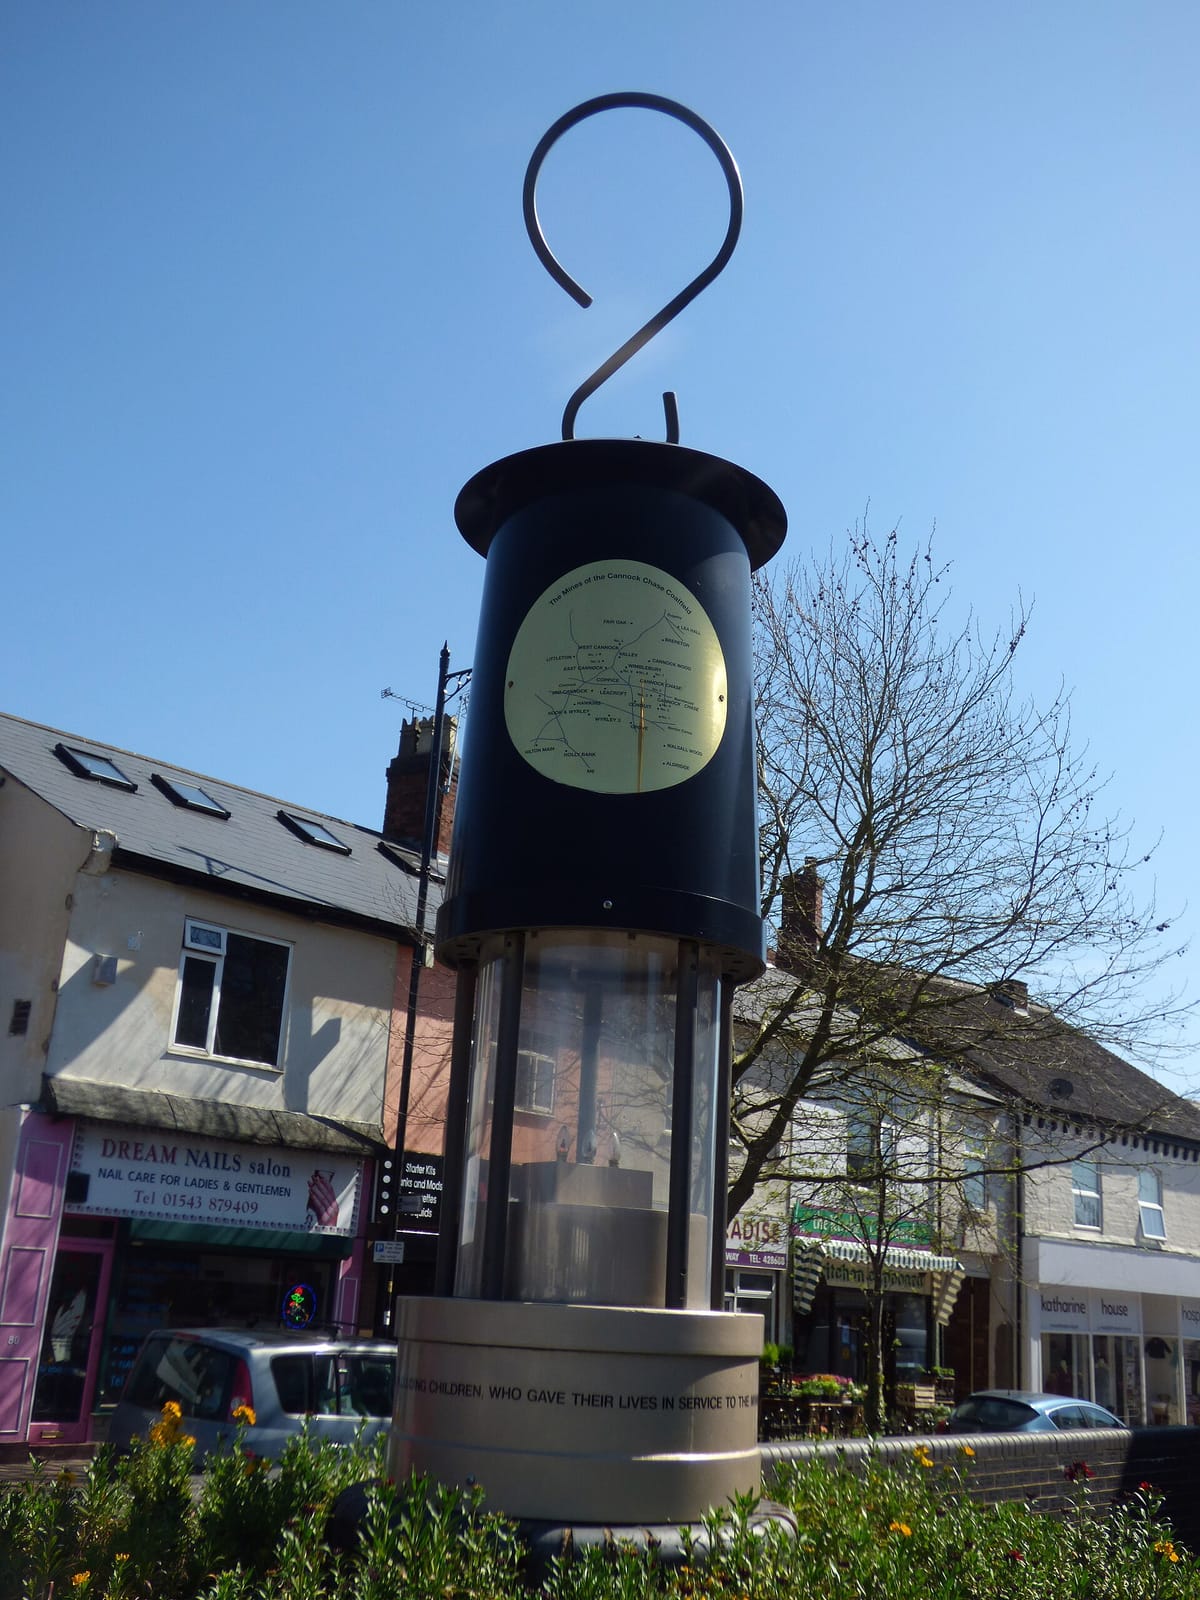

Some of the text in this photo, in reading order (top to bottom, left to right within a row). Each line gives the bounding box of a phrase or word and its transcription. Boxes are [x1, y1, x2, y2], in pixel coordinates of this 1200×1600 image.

[549, 572, 692, 615] The Mines of the Cannock Chase Coalfield
[101, 1138, 290, 1178] DREAM NAILS salon
[405, 1162, 436, 1176] Starter Kits
[97, 1167, 291, 1198] NAIL CARE FOR LADIES & GENTLEMEN
[413, 1179, 426, 1189] and
[426, 1179, 443, 1191] Mods
[134, 1189, 259, 1214] Tel 01543 879409
[1040, 1294, 1086, 1314] katharine
[1101, 1298, 1129, 1317] house
[489, 1386, 522, 1401] WHO
[527, 1389, 566, 1405] GAVE
[571, 1392, 614, 1409] THEIR
[619, 1395, 658, 1410] LIVES
[662, 1396, 675, 1411] IN
[678, 1395, 722, 1410] SERVICE
[725, 1395, 736, 1409] TO
[738, 1394, 750, 1409] THE
